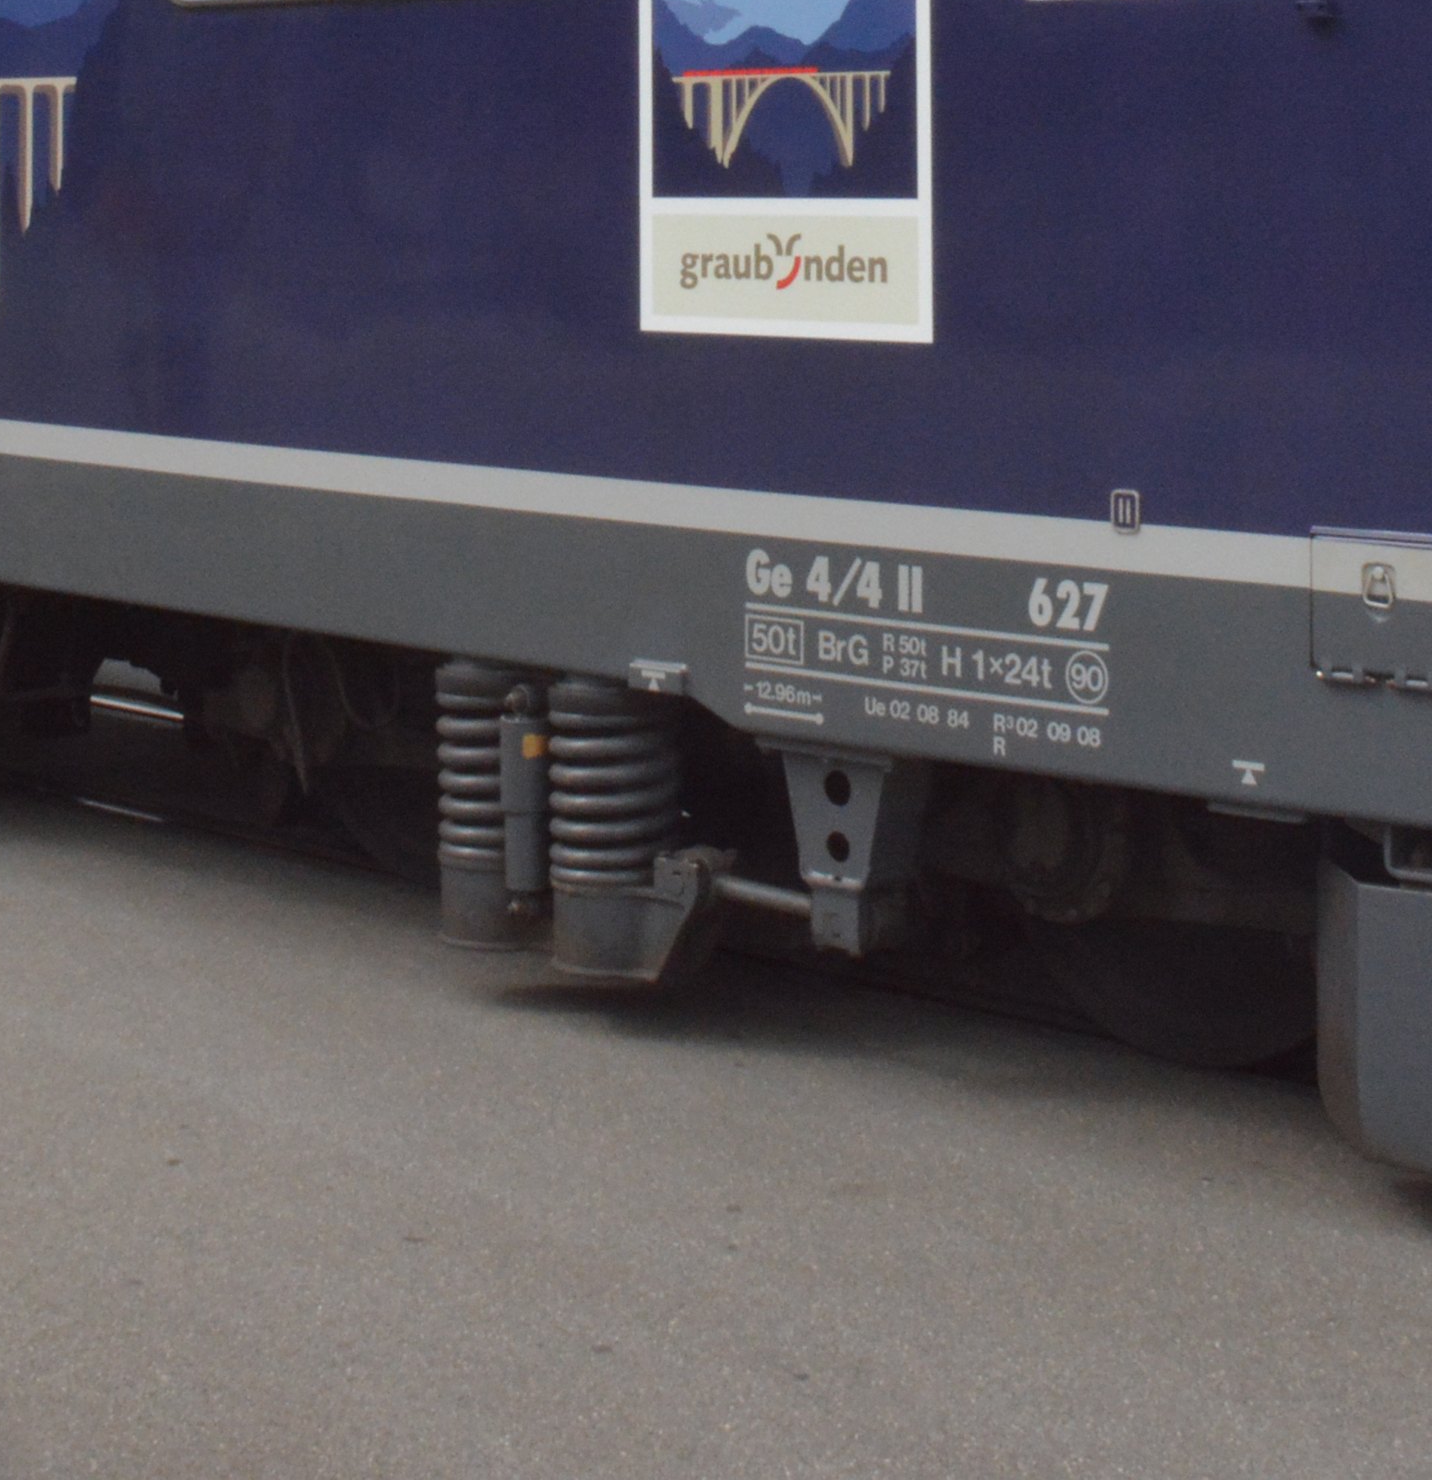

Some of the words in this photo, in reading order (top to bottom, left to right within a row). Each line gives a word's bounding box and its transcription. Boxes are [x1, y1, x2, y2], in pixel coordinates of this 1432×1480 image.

[746, 548, 793, 598] Ge
[806, 556, 882, 609] 4/4
[898, 564, 923, 613] II
[1028, 577, 1110, 632] 627
[752, 623, 797, 656] 50t
[819, 630, 870, 666] BrG
[883, 633, 896, 653] R
[899, 635, 927, 657] 50t
[883, 656, 894, 675] P
[900, 658, 927, 680] 37t
[941, 645, 962, 678] H
[1071, 662, 1104, 692] 90
[864, 696, 886, 716] Ue
[889, 699, 911, 720] 02
[917, 704, 939, 726] 08
[947, 708, 969, 729] 84
[1016, 717, 1038, 738] 02
[1047, 721, 1071, 743] 09
[1077, 725, 1101, 748] 08
